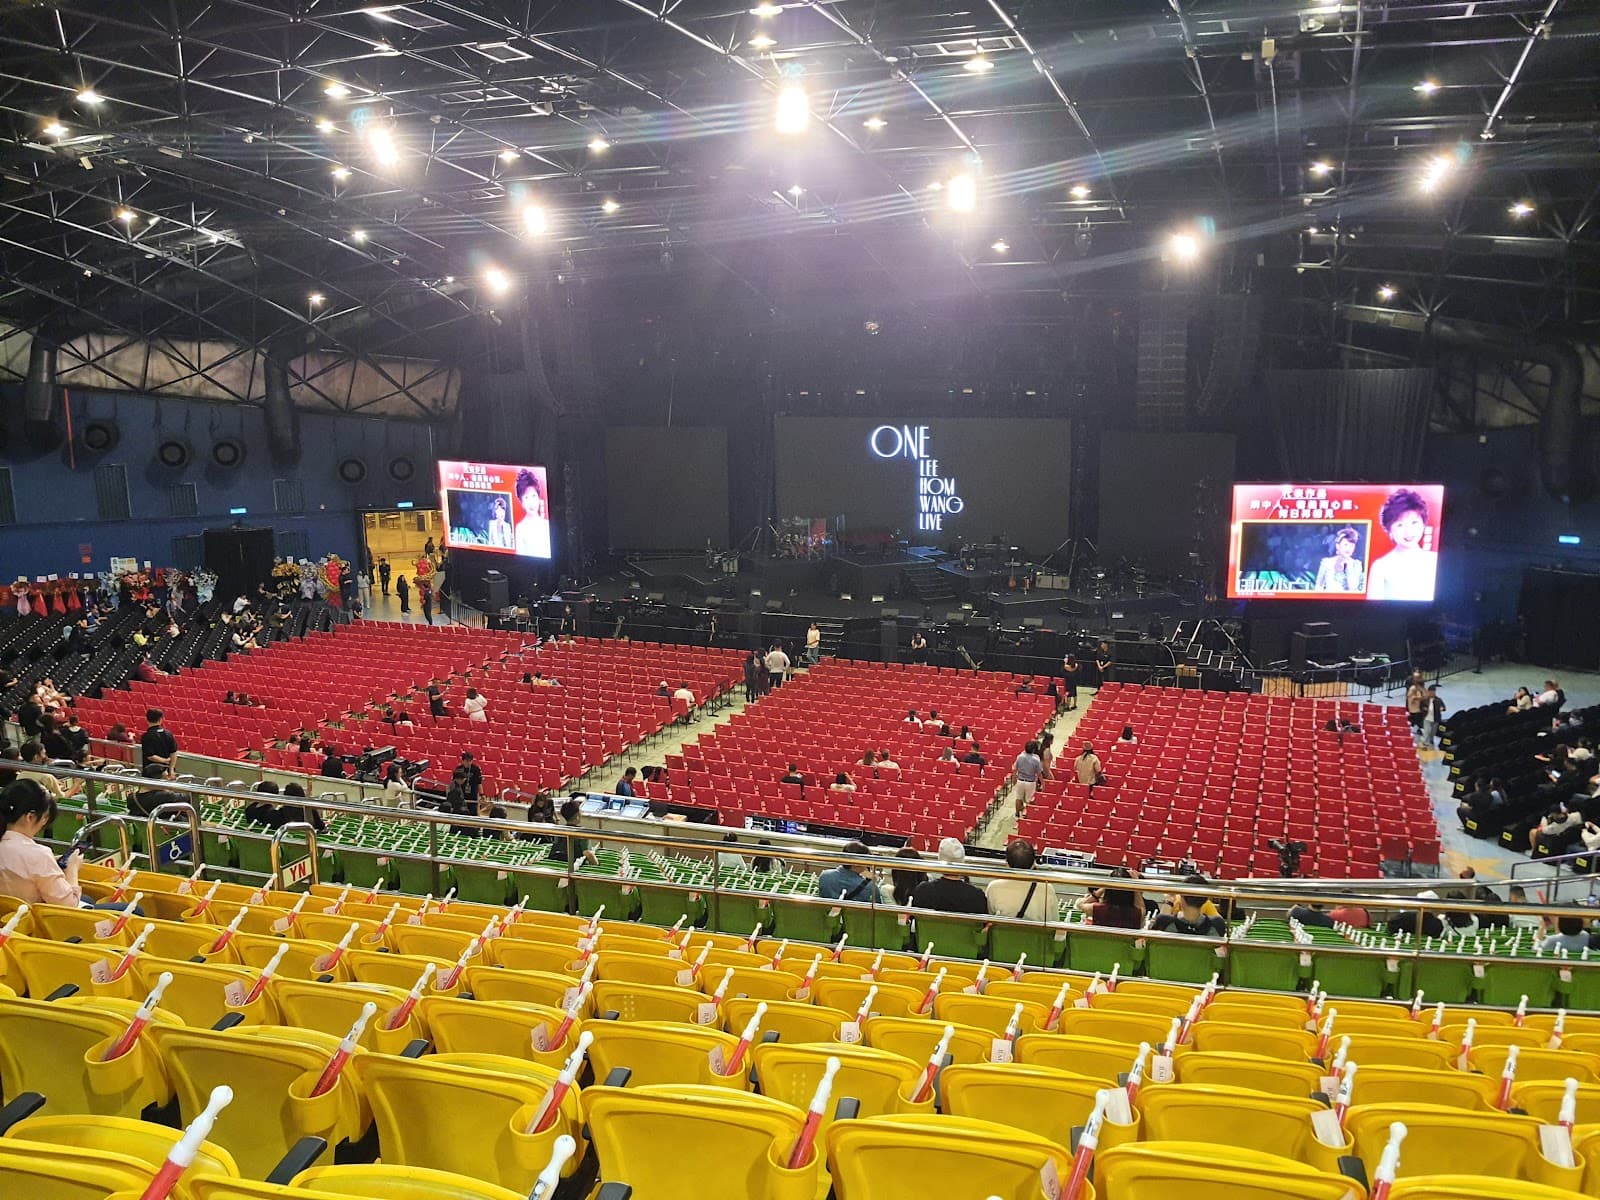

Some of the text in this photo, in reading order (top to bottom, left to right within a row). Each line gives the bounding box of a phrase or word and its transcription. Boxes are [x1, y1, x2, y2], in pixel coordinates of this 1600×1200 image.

[871, 424, 930, 459] ONE
[920, 459, 938, 477] LEE
[920, 477, 955, 496] HOM
[920, 495, 964, 514] WANG
[919, 513, 943, 530] LIVE
[290, 861, 306, 881] YN
